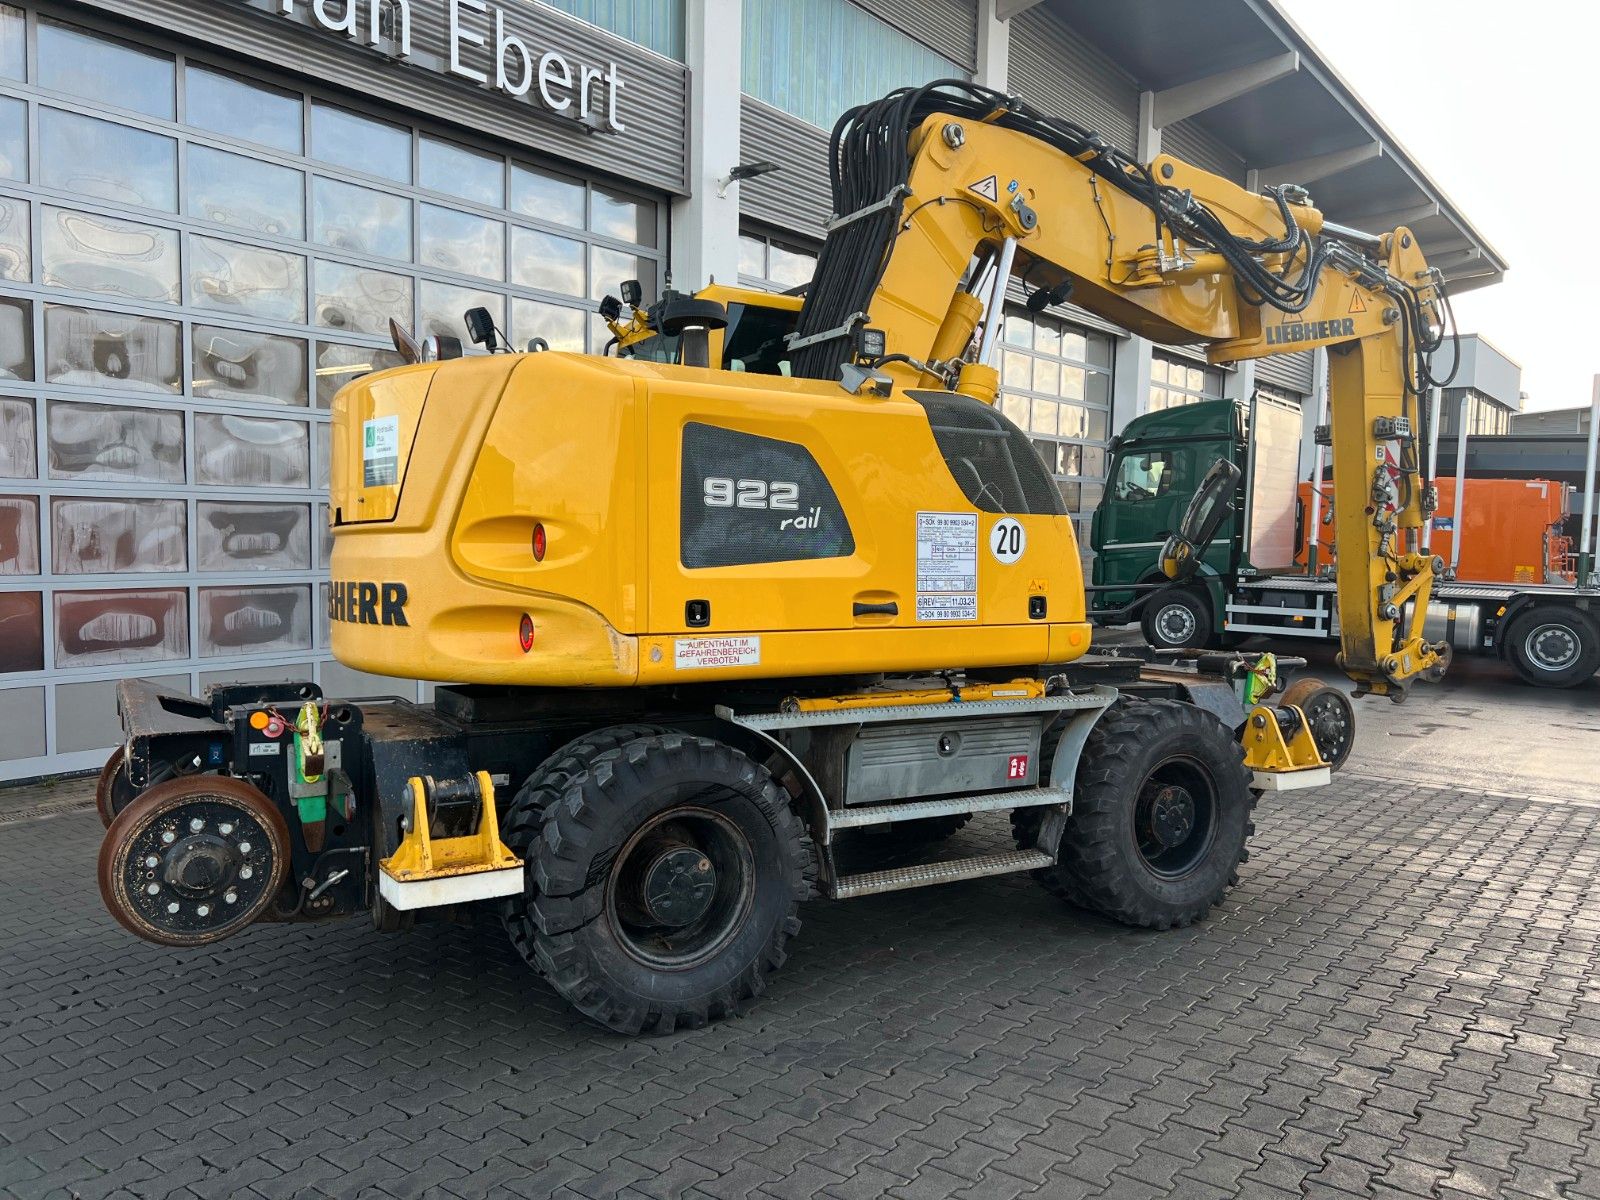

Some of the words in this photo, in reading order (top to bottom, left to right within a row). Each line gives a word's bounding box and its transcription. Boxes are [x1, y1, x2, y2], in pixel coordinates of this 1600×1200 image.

[280, 0, 411, 56] an
[449, 0, 625, 132] Ebert
[1266, 317, 1355, 345] LIEBHERR
[703, 477, 800, 511] 922
[780, 506, 821, 531] rail
[996, 524, 1021, 555] 20
[924, 597, 935, 607] REV
[952, 597, 975, 606] 11.03.24
[680, 647, 756, 658] GEFAHRENBEREICH
[740, 639, 749, 647] IM
[697, 656, 740, 666] VERBOTEN
